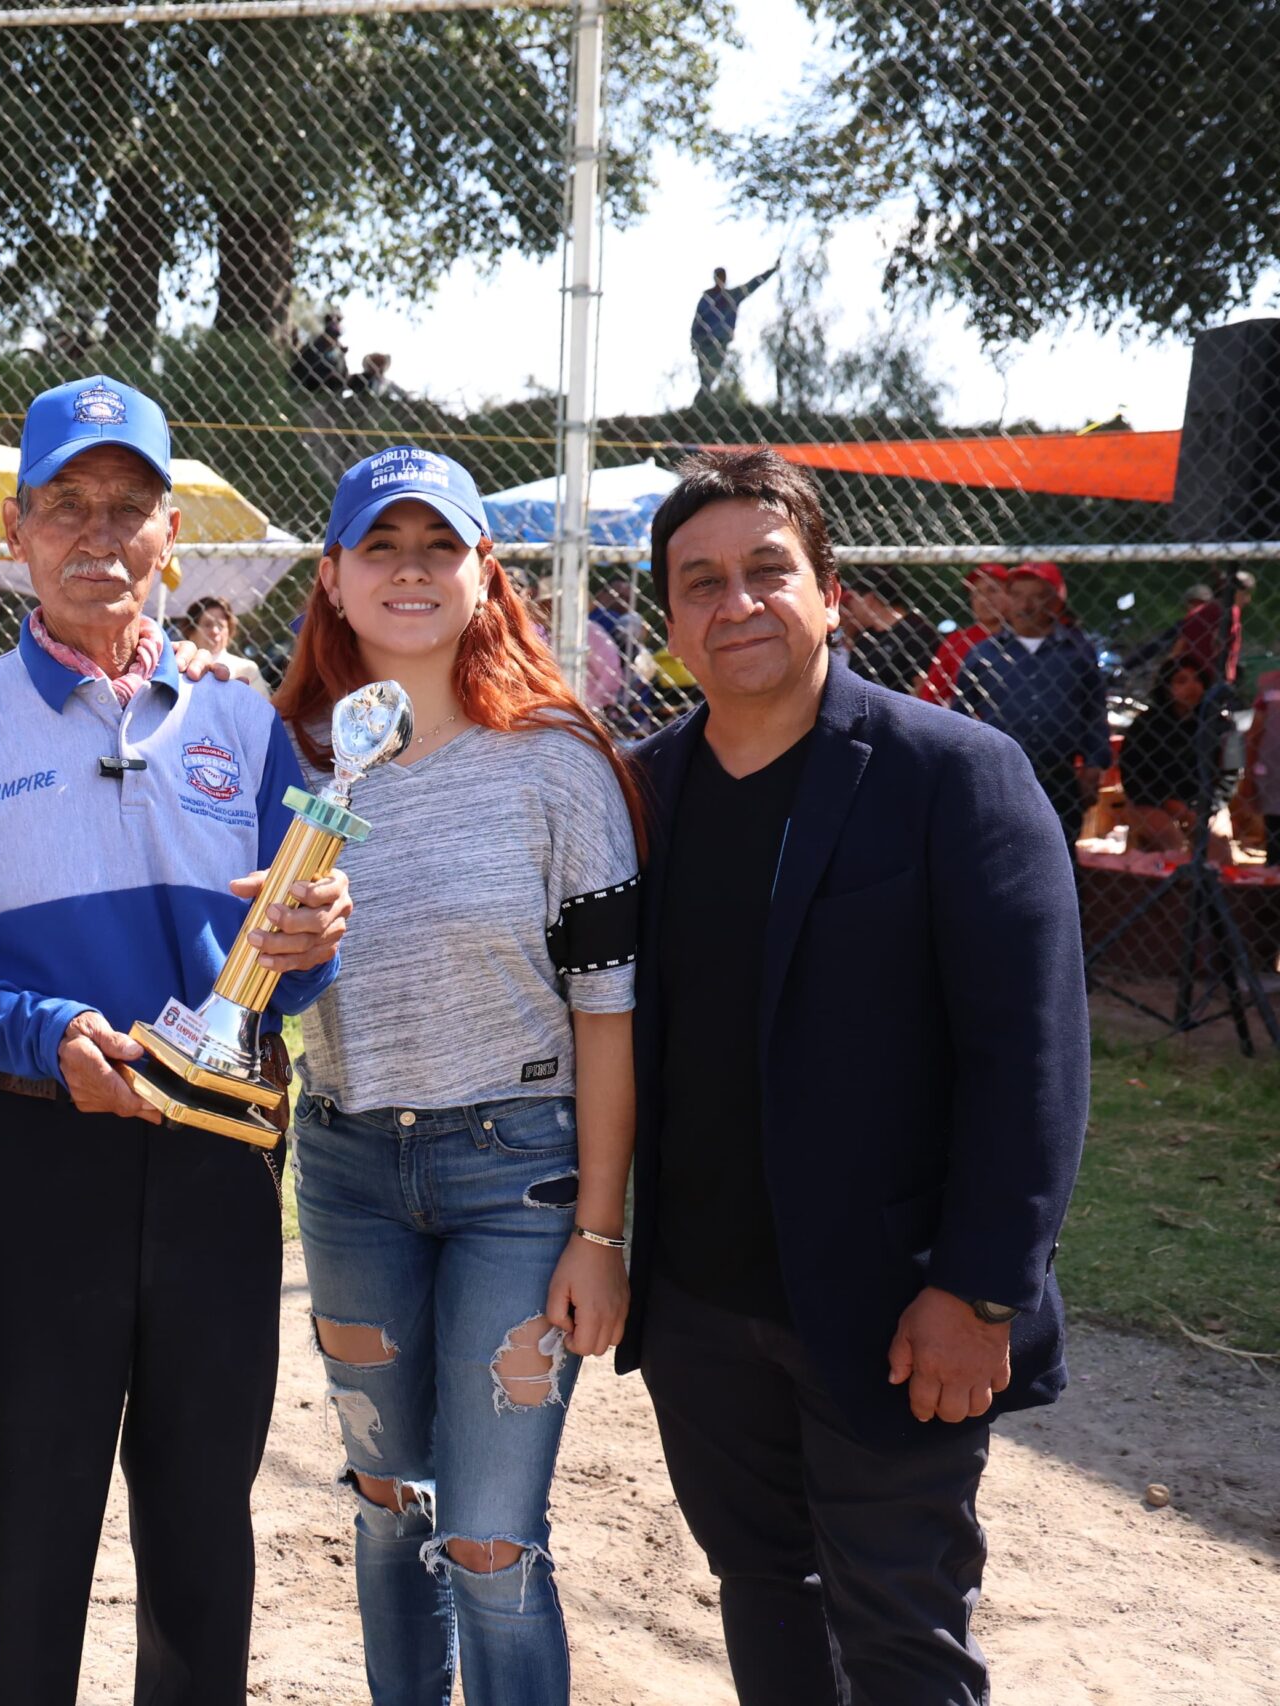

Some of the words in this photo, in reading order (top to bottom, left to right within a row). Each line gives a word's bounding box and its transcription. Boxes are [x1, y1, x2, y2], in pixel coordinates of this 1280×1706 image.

[370, 449, 409, 470] WORLD
[371, 470, 449, 490] CHAMPIONS
[525, 1061, 556, 1078] PINK
